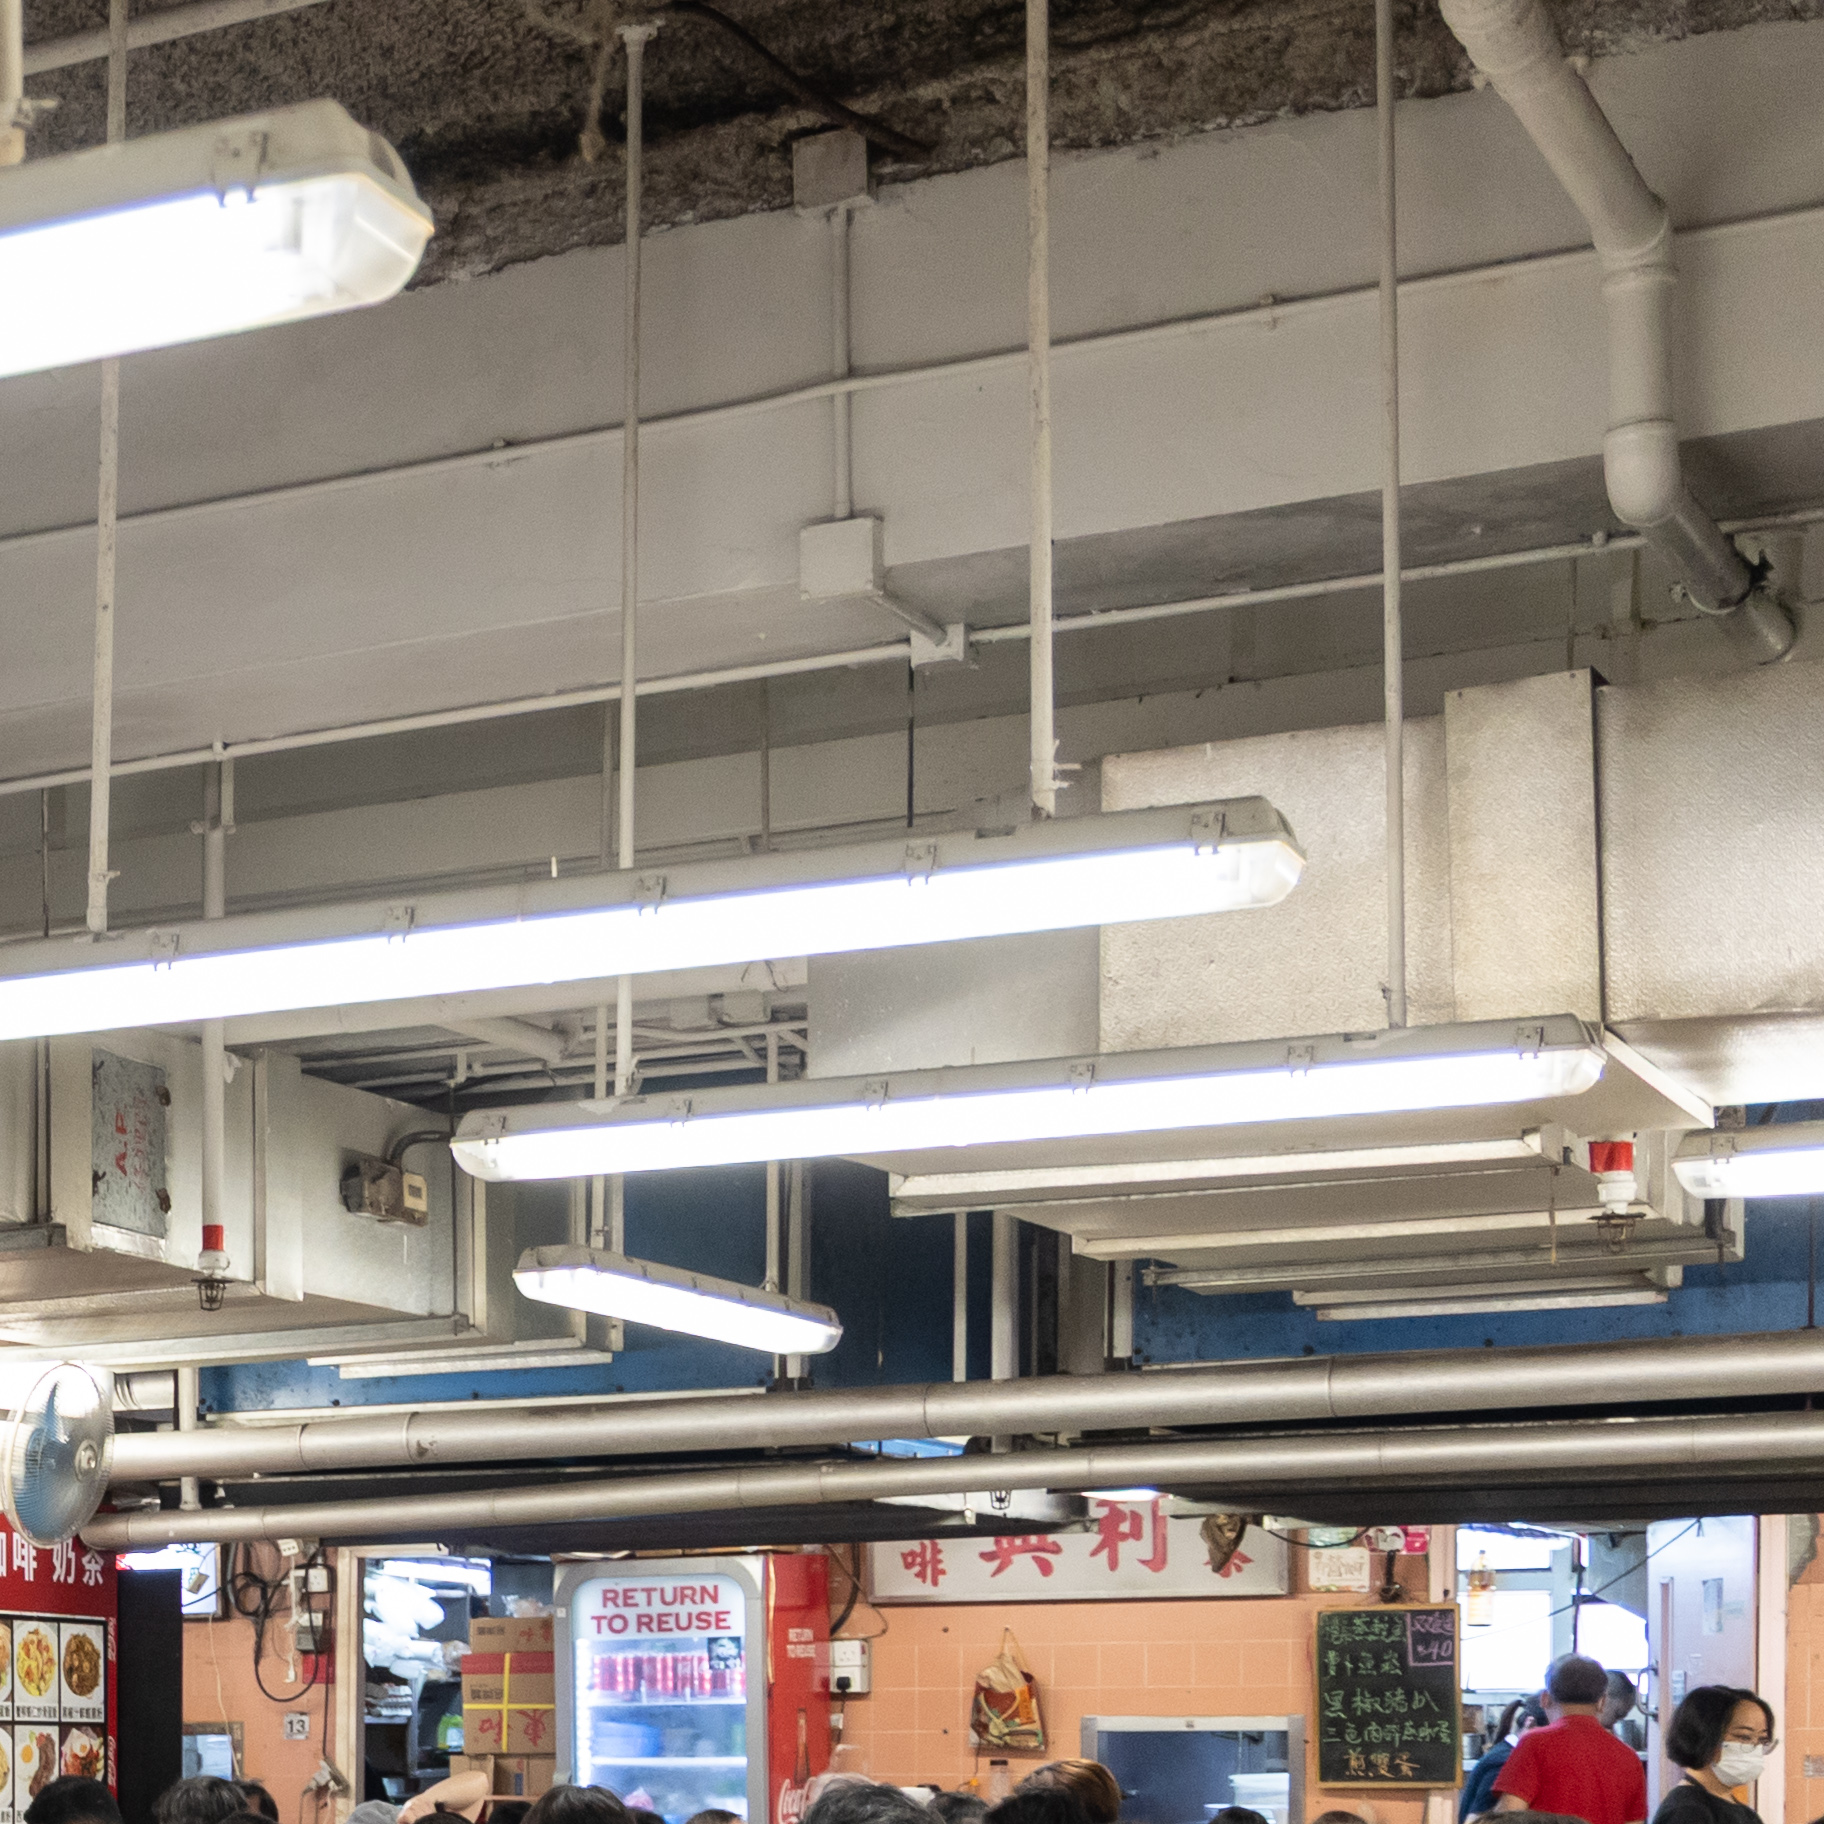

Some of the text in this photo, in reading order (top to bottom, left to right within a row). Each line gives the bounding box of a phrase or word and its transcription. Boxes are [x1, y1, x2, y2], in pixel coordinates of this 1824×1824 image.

[602, 1584, 720, 1609] RETURN
[591, 1610, 732, 1635] TO REUSE
[288, 1719, 306, 1734] 13
